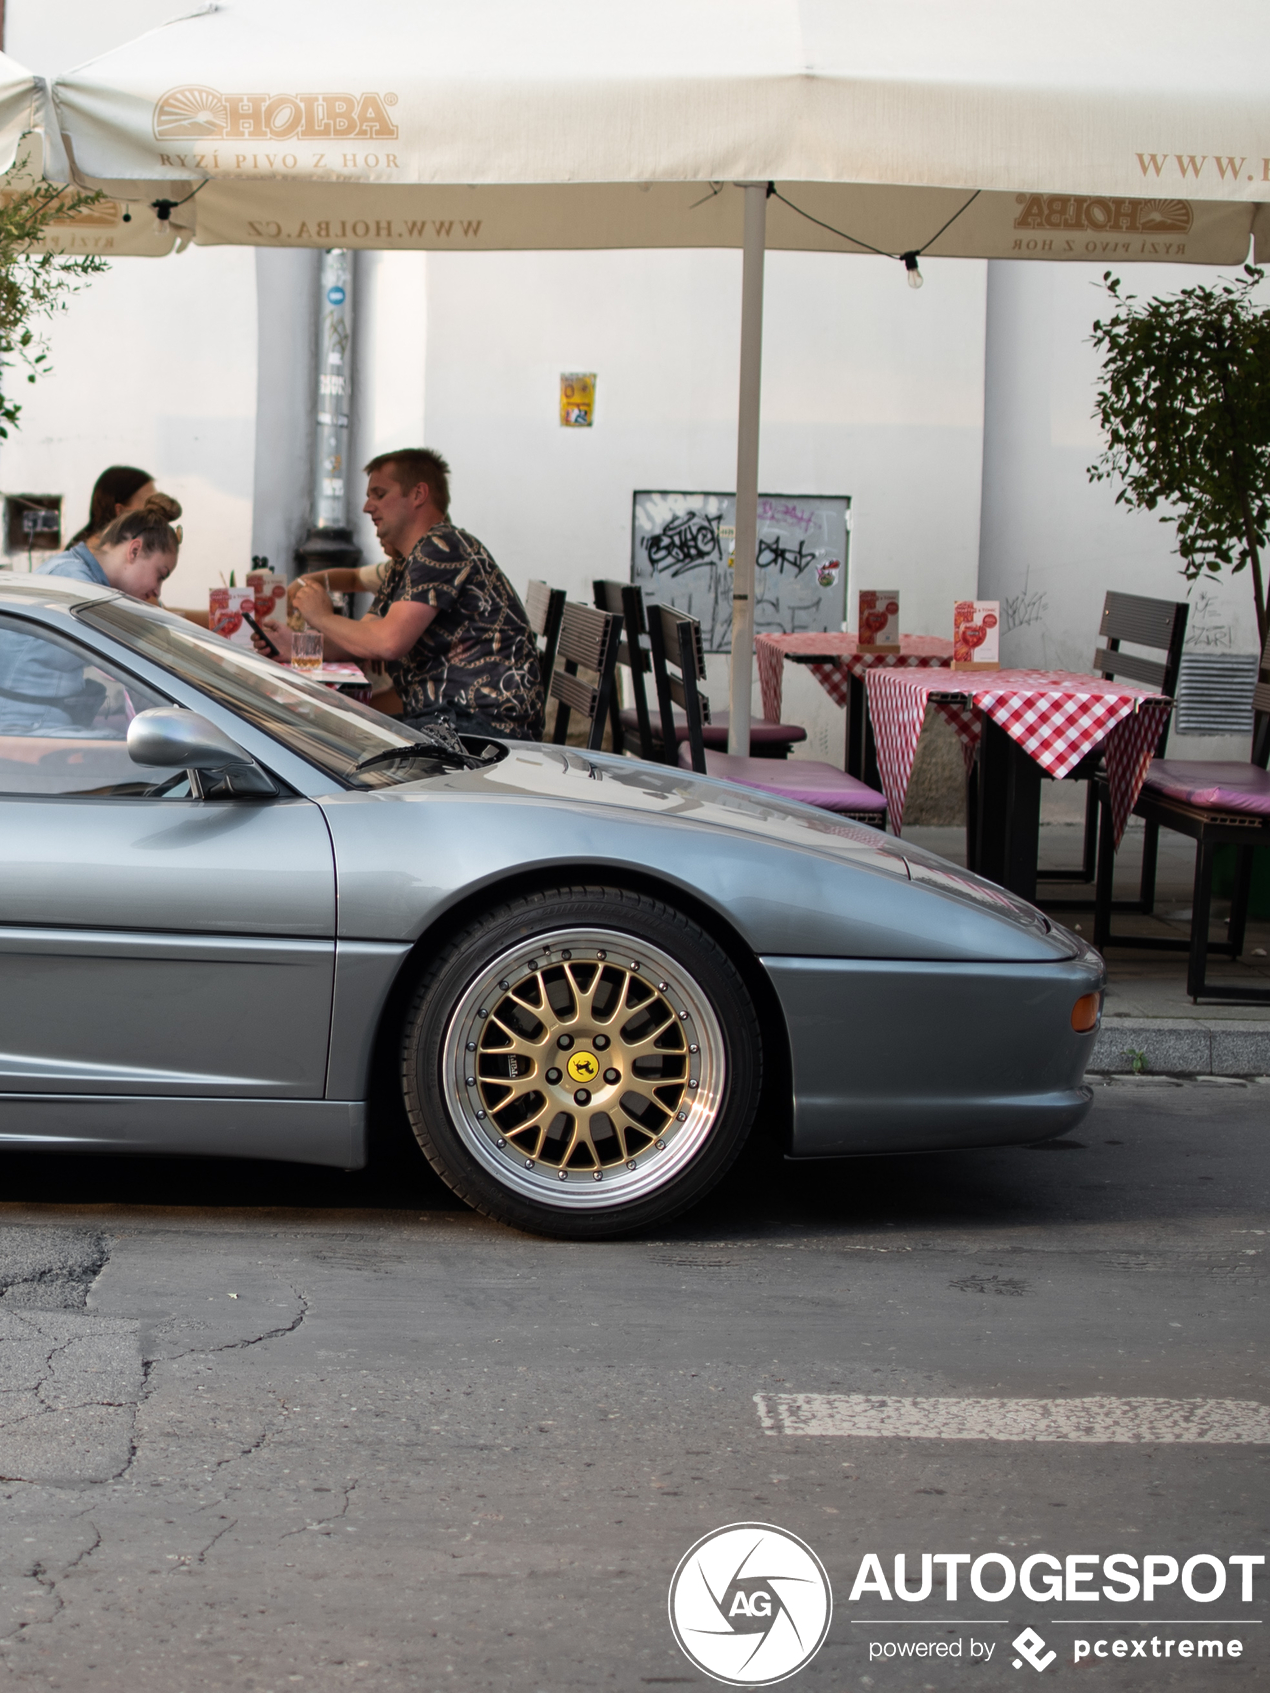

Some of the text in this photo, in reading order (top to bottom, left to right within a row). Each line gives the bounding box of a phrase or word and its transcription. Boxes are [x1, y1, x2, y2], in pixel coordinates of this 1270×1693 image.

[159, 150, 401, 169] RYZÍ PIVO Z HOR
